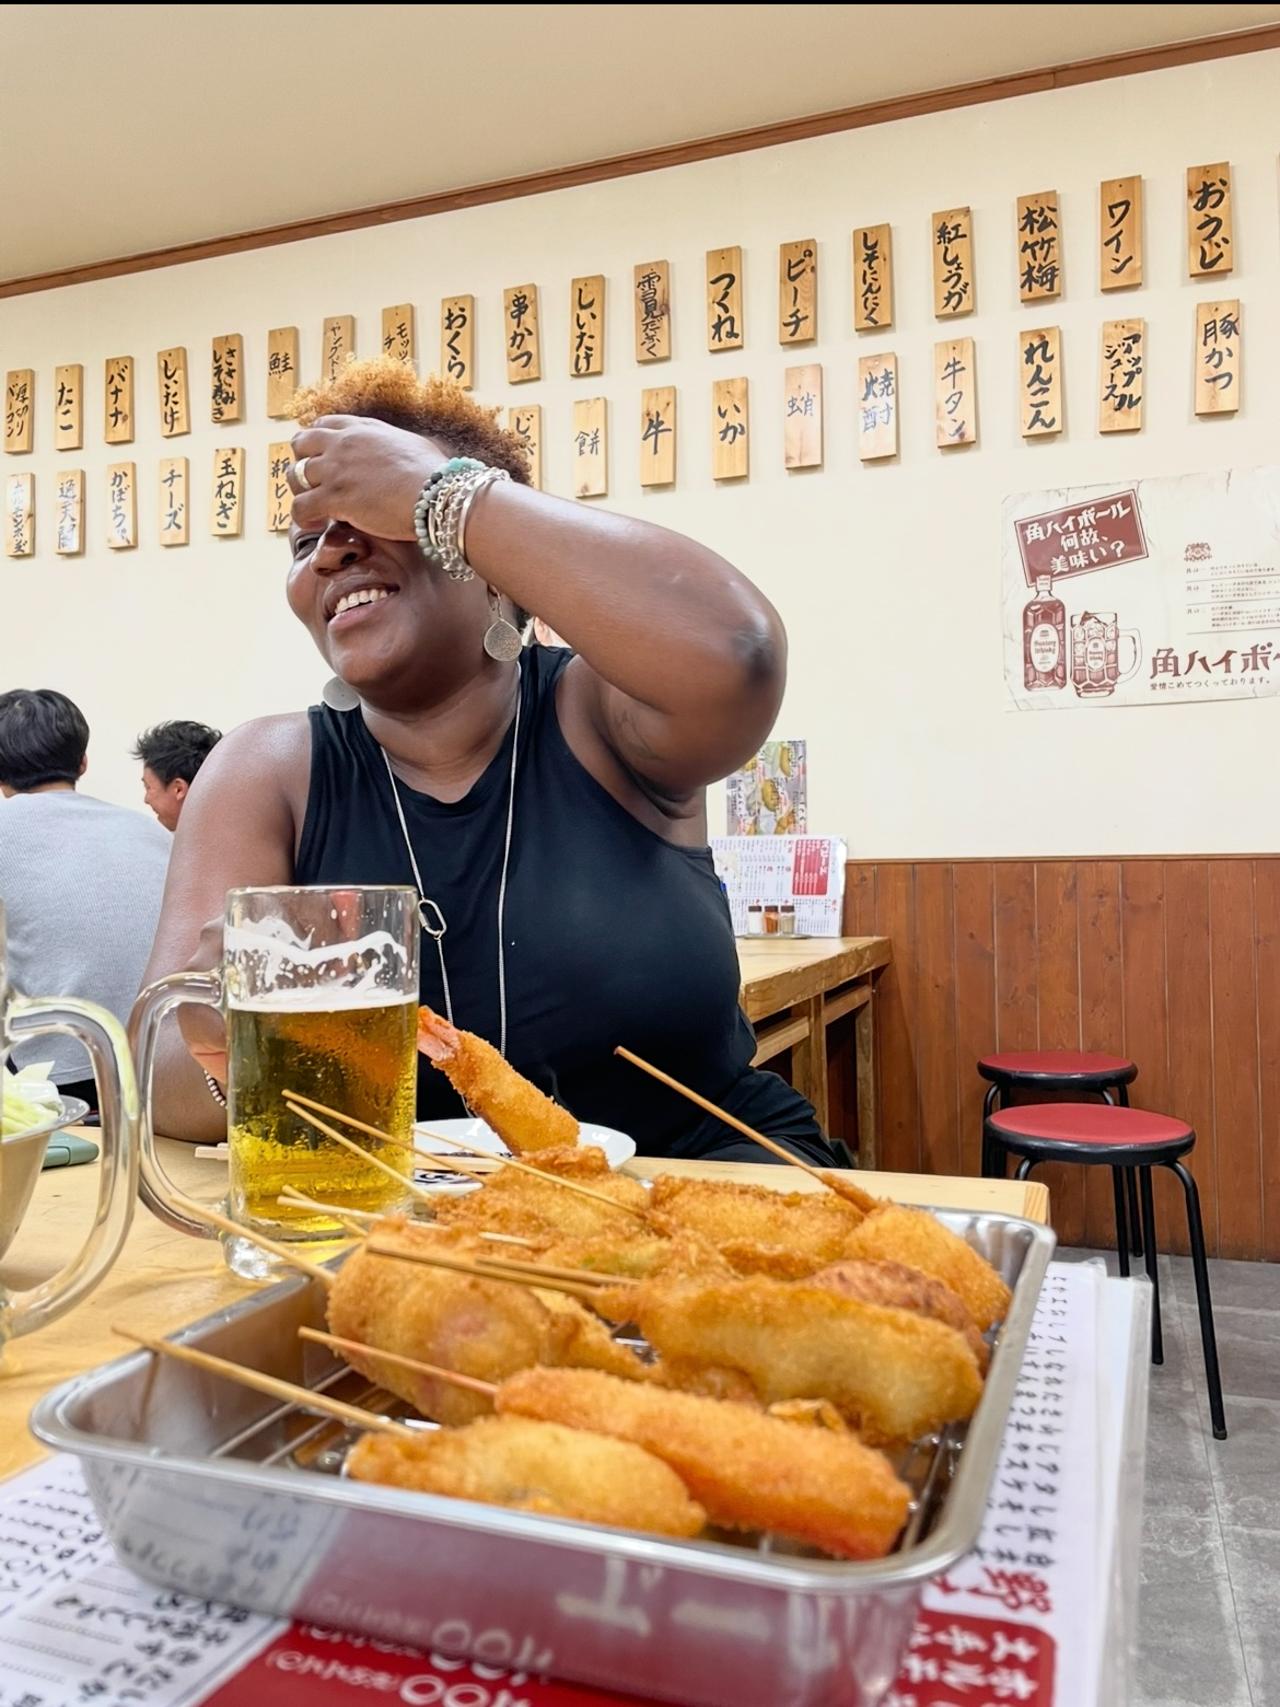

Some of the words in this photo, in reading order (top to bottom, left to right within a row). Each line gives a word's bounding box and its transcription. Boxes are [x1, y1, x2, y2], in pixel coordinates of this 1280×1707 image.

[1019, 205, 1060, 293] 松竹梅
[1104, 199, 1134, 274] ワイン
[709, 272, 740, 343] つくね
[783, 249, 813, 337] ピーチ
[862, 231, 882, 325] しそにんにく
[269, 352, 294, 376] 鮭
[445, 307, 467, 379] おくら
[510, 293, 533, 369] 串かつ
[574, 287, 597, 374] しいたけ
[1203, 312, 1240, 391] 豚かつ
[57, 381, 74, 432] たこ
[109, 364, 129, 428] バナナ
[163, 359, 181, 432] しいたけ
[861, 368, 895, 433] 焼酎
[941, 357, 967, 439] 牛タン
[1024, 339, 1056, 431] れんこん
[1103, 344, 1124, 401] ジュース
[1115, 332, 1142, 412] アップル
[574, 428, 601, 456] 餅
[642, 411, 673, 456] 牛
[717, 404, 746, 445] いか
[161, 468, 183, 531] チーズ
[215, 457, 237, 530] 玉ねぎ
[1025, 500, 1132, 545] 角ハイボール
